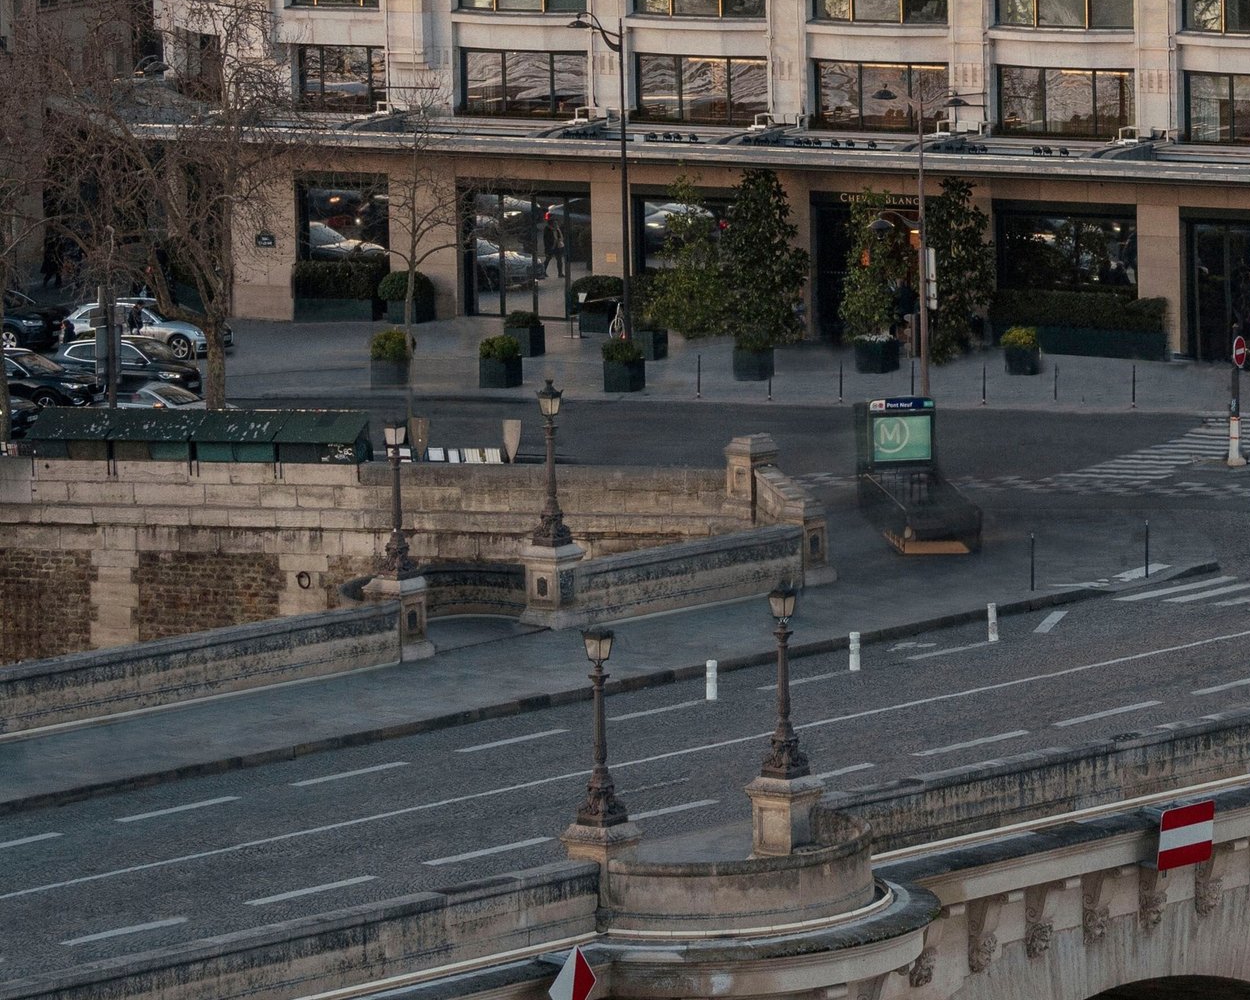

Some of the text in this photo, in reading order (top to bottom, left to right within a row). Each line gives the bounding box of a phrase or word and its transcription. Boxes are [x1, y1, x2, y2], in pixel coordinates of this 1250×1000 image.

[840, 193, 919, 206] CHEV BLANC
[880, 423, 901, 445] M
